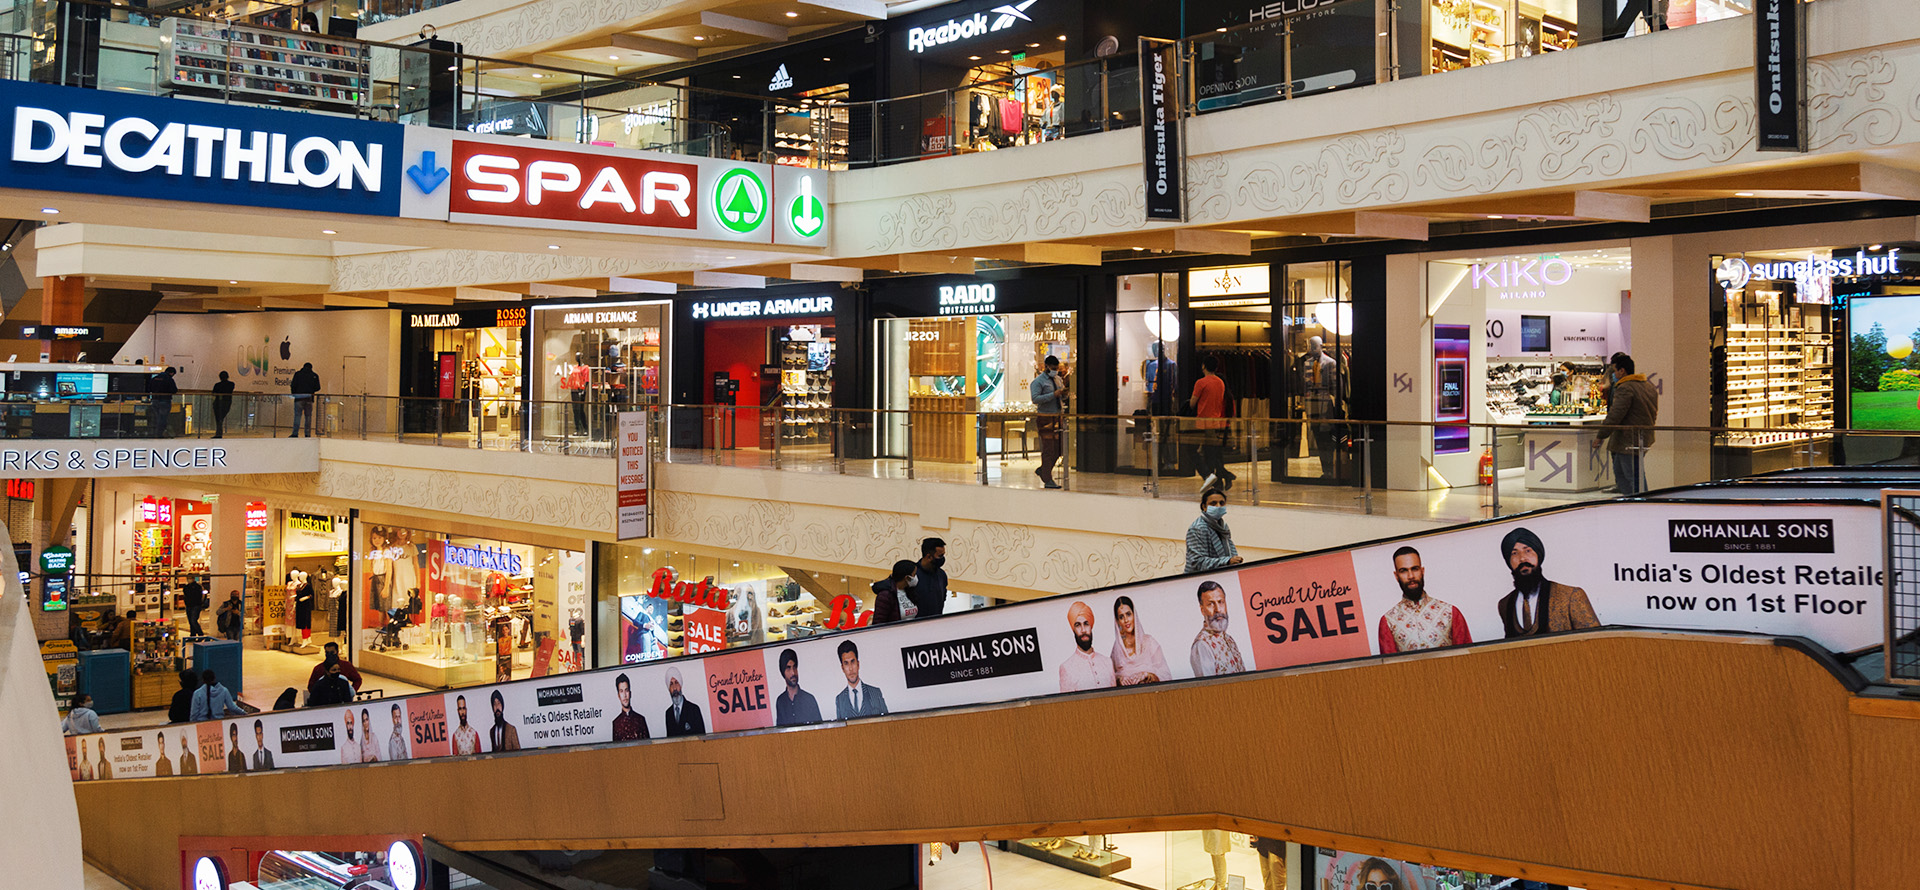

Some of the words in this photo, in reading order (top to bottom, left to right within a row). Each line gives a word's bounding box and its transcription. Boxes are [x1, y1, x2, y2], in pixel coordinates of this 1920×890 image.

[1249, 24, 1265, 33] THE
[1306, 8, 1336, 20] STORE
[907, 12, 988, 53] Reebok
[1767, 0, 1782, 114] Onitsuk
[769, 77, 793, 91] adidas
[1152, 53, 1166, 104] Tiger
[1200, 80, 1234, 96] OPENING
[1235, 75, 1257, 90] SOON
[12, 105, 383, 192] DECATHLON
[1154, 107, 1168, 195] Onitsuka
[464, 153, 692, 218] SPAR
[1472, 258, 1574, 289] KIKO
[1752, 254, 1852, 284] sunglass
[1856, 250, 1900, 275] hut
[939, 283, 996, 305] RADO
[1500, 290, 1546, 299] MILANO
[496, 308, 526, 319] ROSSO
[563, 312, 594, 324] ARMANI
[595, 311, 638, 323] EXCHANGE
[710, 300, 762, 318] UNDER
[763, 296, 833, 316] ARMOUR
[939, 304, 996, 315] SWITZERLAND
[55, 327, 89, 335] amazon
[411, 314, 424, 327] DA
[424, 313, 460, 327] MILANO
[496, 318, 526, 327] BRUNELLO
[627, 432, 638, 442] YOU
[67, 449, 86, 470] &
[93, 447, 228, 470] SPENCER
[622, 446, 644, 456] NOTICED
[627, 461, 639, 471] THIS
[288, 516, 332, 533] mustard
[1674, 524, 1771, 539] MOHANLAL
[1777, 524, 1829, 539] SONS
[444, 539, 523, 575] iconickids
[430, 551, 482, 587] SALE
[1614, 562, 1693, 582] India's
[1701, 563, 1787, 585] Oldest
[647, 567, 731, 610] Bata
[1250, 586, 1296, 617] Grand
[1296, 580, 1352, 603] Winter
[1646, 595, 1697, 611] now
[1705, 596, 1737, 612] on
[1748, 593, 1786, 613] 1st
[1794, 594, 1867, 615] Floor
[687, 620, 722, 643] SALE
[1264, 600, 1359, 644] SALE
[625, 649, 665, 661] CONFIDENT
[907, 642, 987, 670] MOHANLAL
[992, 634, 1035, 658] SONS
[709, 673, 735, 693] Grand
[734, 669, 763, 685] Winter
[950, 668, 973, 680] SINCE
[976, 666, 994, 677] 1881
[538, 688, 566, 699] MOHANLAL
[566, 685, 581, 695] SONS
[717, 684, 767, 714] SALE
[523, 713, 547, 725] India's
[548, 711, 572, 723] Oldest
[573, 707, 603, 720] Retailer
[282, 729, 315, 742] MOHANLAL
[315, 726, 334, 740] SONS
[415, 722, 447, 744] SALE
[534, 730, 549, 739] now
[550, 728, 560, 738] on
[562, 726, 573, 737] 1st
[574, 724, 595, 736] Floor
[202, 743, 225, 761] SALE
